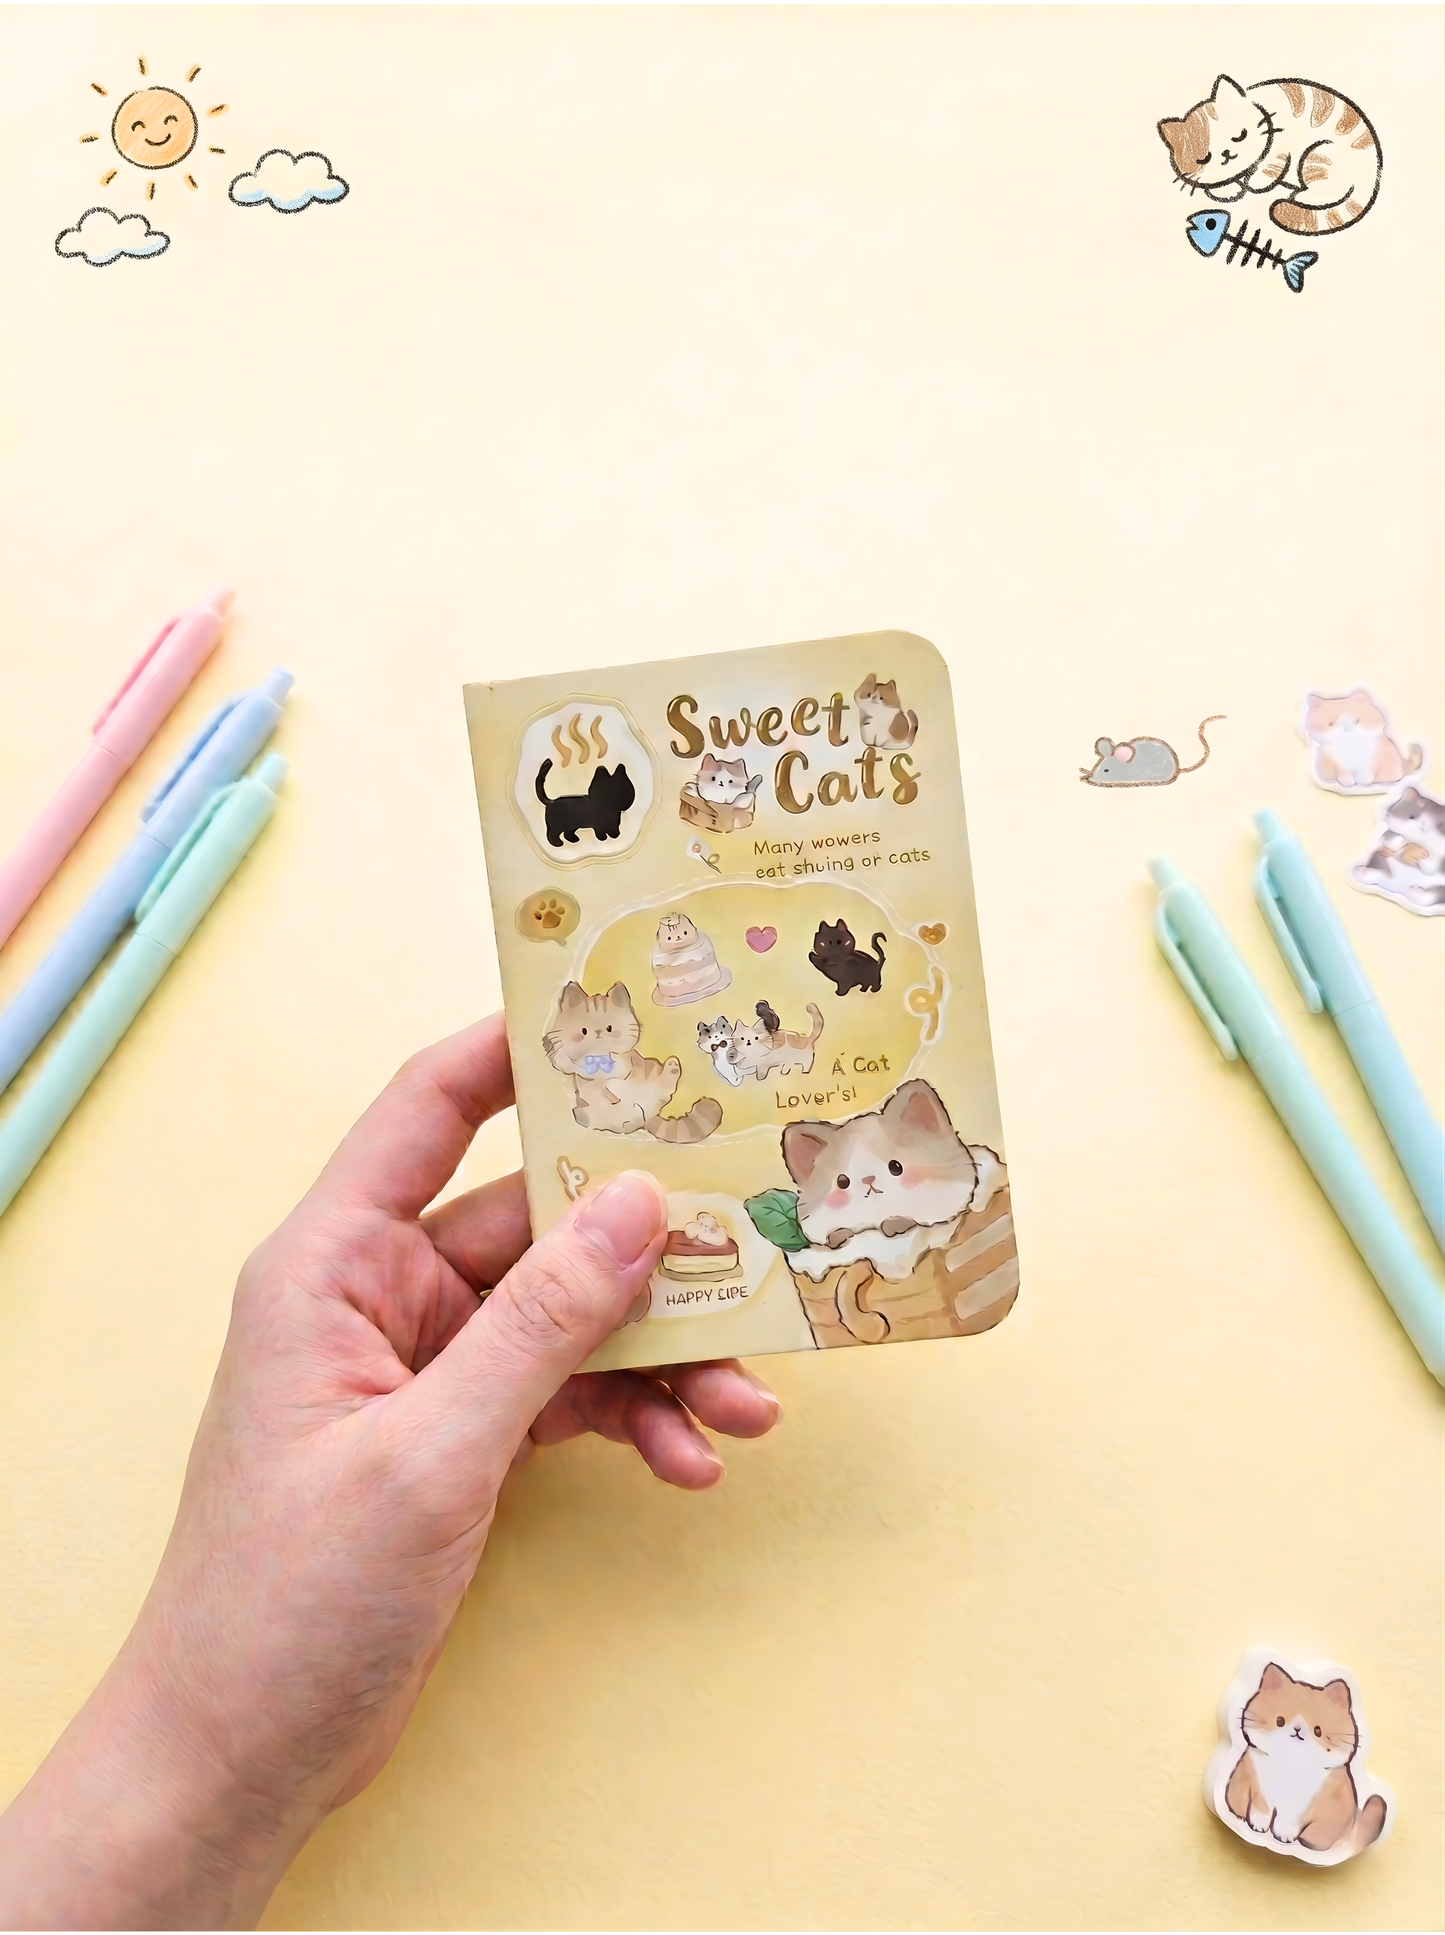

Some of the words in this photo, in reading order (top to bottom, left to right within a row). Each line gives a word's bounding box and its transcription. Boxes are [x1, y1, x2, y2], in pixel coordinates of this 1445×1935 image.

[666, 692, 850, 759] Sweet
[774, 747, 922, 815] Cats
[754, 840, 804, 856] Many
[811, 831, 881, 850] wowers
[755, 862, 786, 879] eat
[861, 855, 882, 868] or
[888, 848, 932, 865] cats
[853, 1054, 891, 1074] Cat
[665, 1288, 714, 1306] HAPPY
